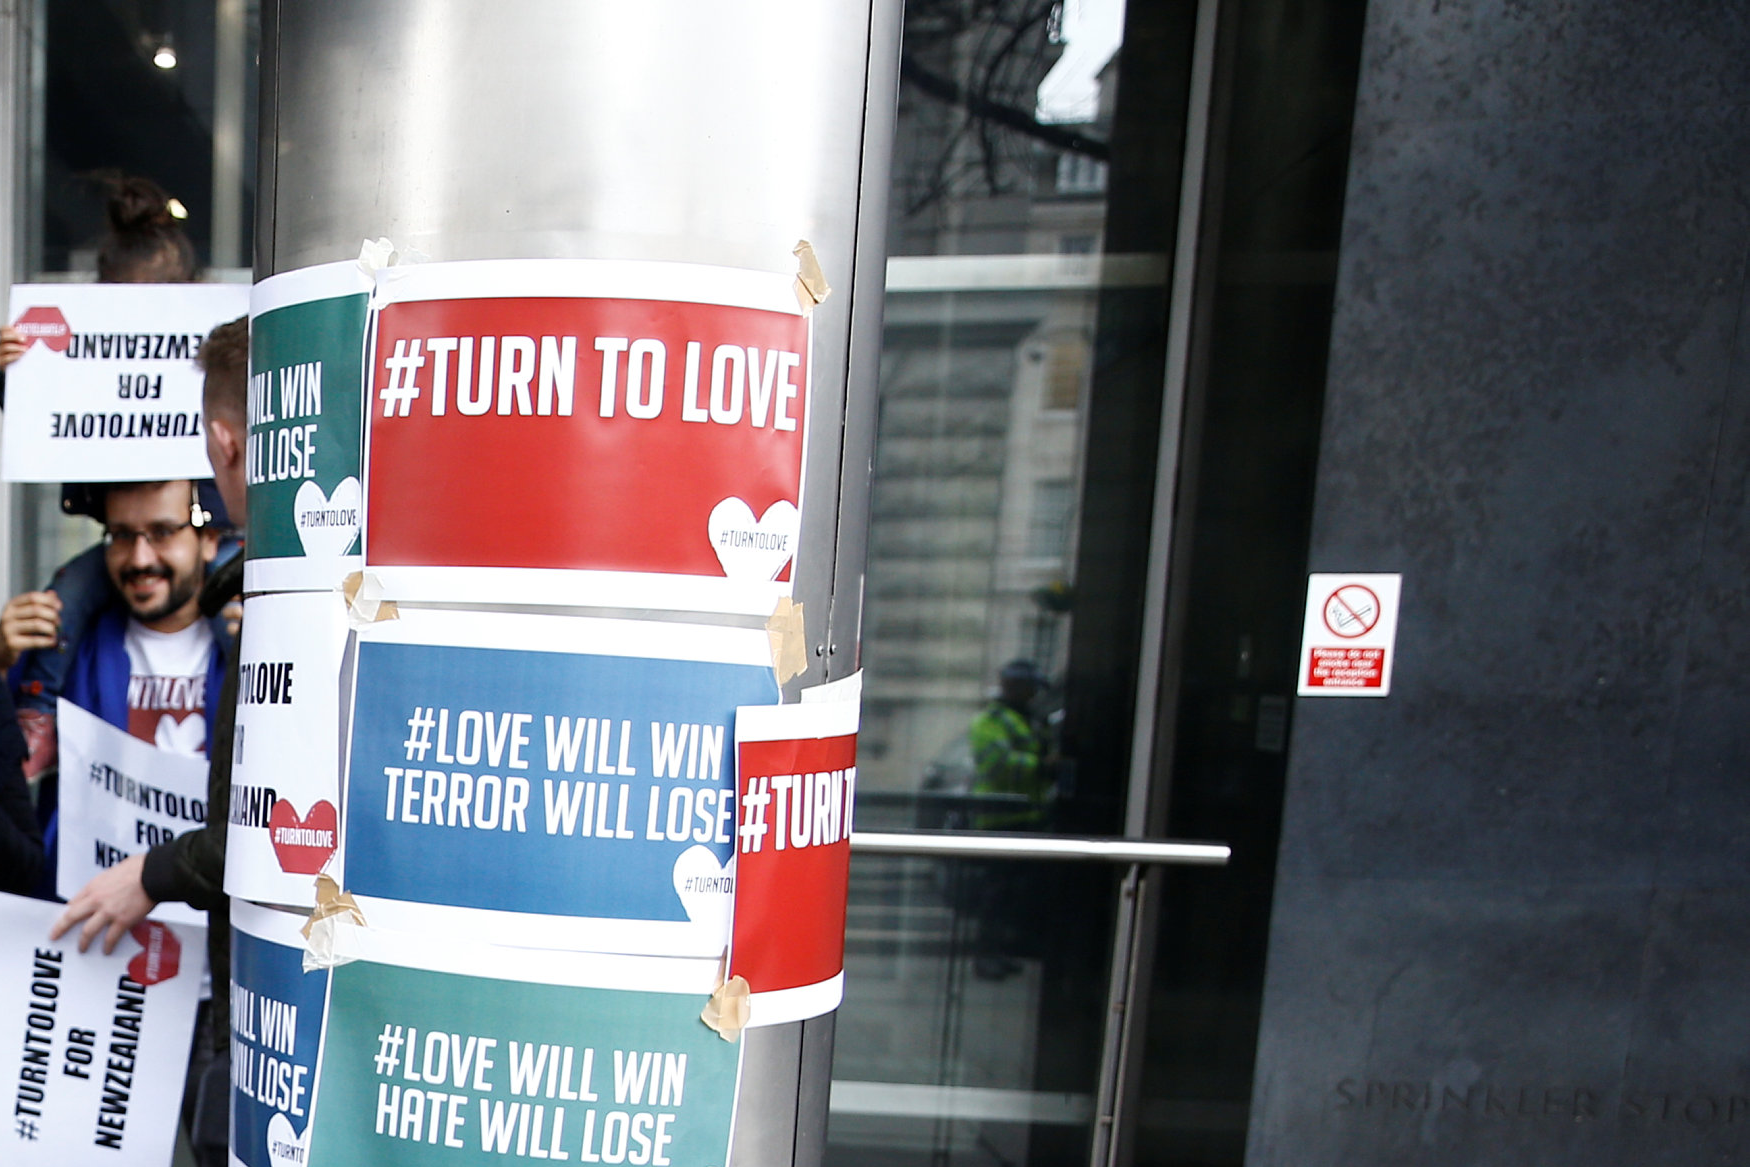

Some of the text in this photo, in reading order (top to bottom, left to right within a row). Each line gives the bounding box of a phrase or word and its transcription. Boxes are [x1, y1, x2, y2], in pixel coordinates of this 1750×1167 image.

[118, 374, 162, 399] FOR
[280, 361, 321, 420] WIN
[379, 336, 800, 431] #TURN TO LOVE
[51, 413, 201, 438] TURNTOLOVE
[268, 424, 317, 482] LOSE
[300, 508, 357, 527] #TURNTOLOVE
[720, 529, 788, 552] #TURNTOLOVE
[404, 706, 724, 780] #LOVE WILL WIN
[90, 763, 207, 823] #TURNTOLO
[384, 767, 734, 843] TERROR WILL LOSE
[739, 771, 843, 853] #TURN
[274, 827, 333, 847] #TURNTOLOVE
[14, 947, 62, 1141] #TURNTOLOVE
[63, 1027, 96, 1079] FOR
[260, 996, 297, 1056] WIN
[257, 1052, 308, 1117] LOSE
[374, 1023, 687, 1107] #LOVE WILL WIN
[376, 1083, 675, 1166] HATE WILL LOSE
